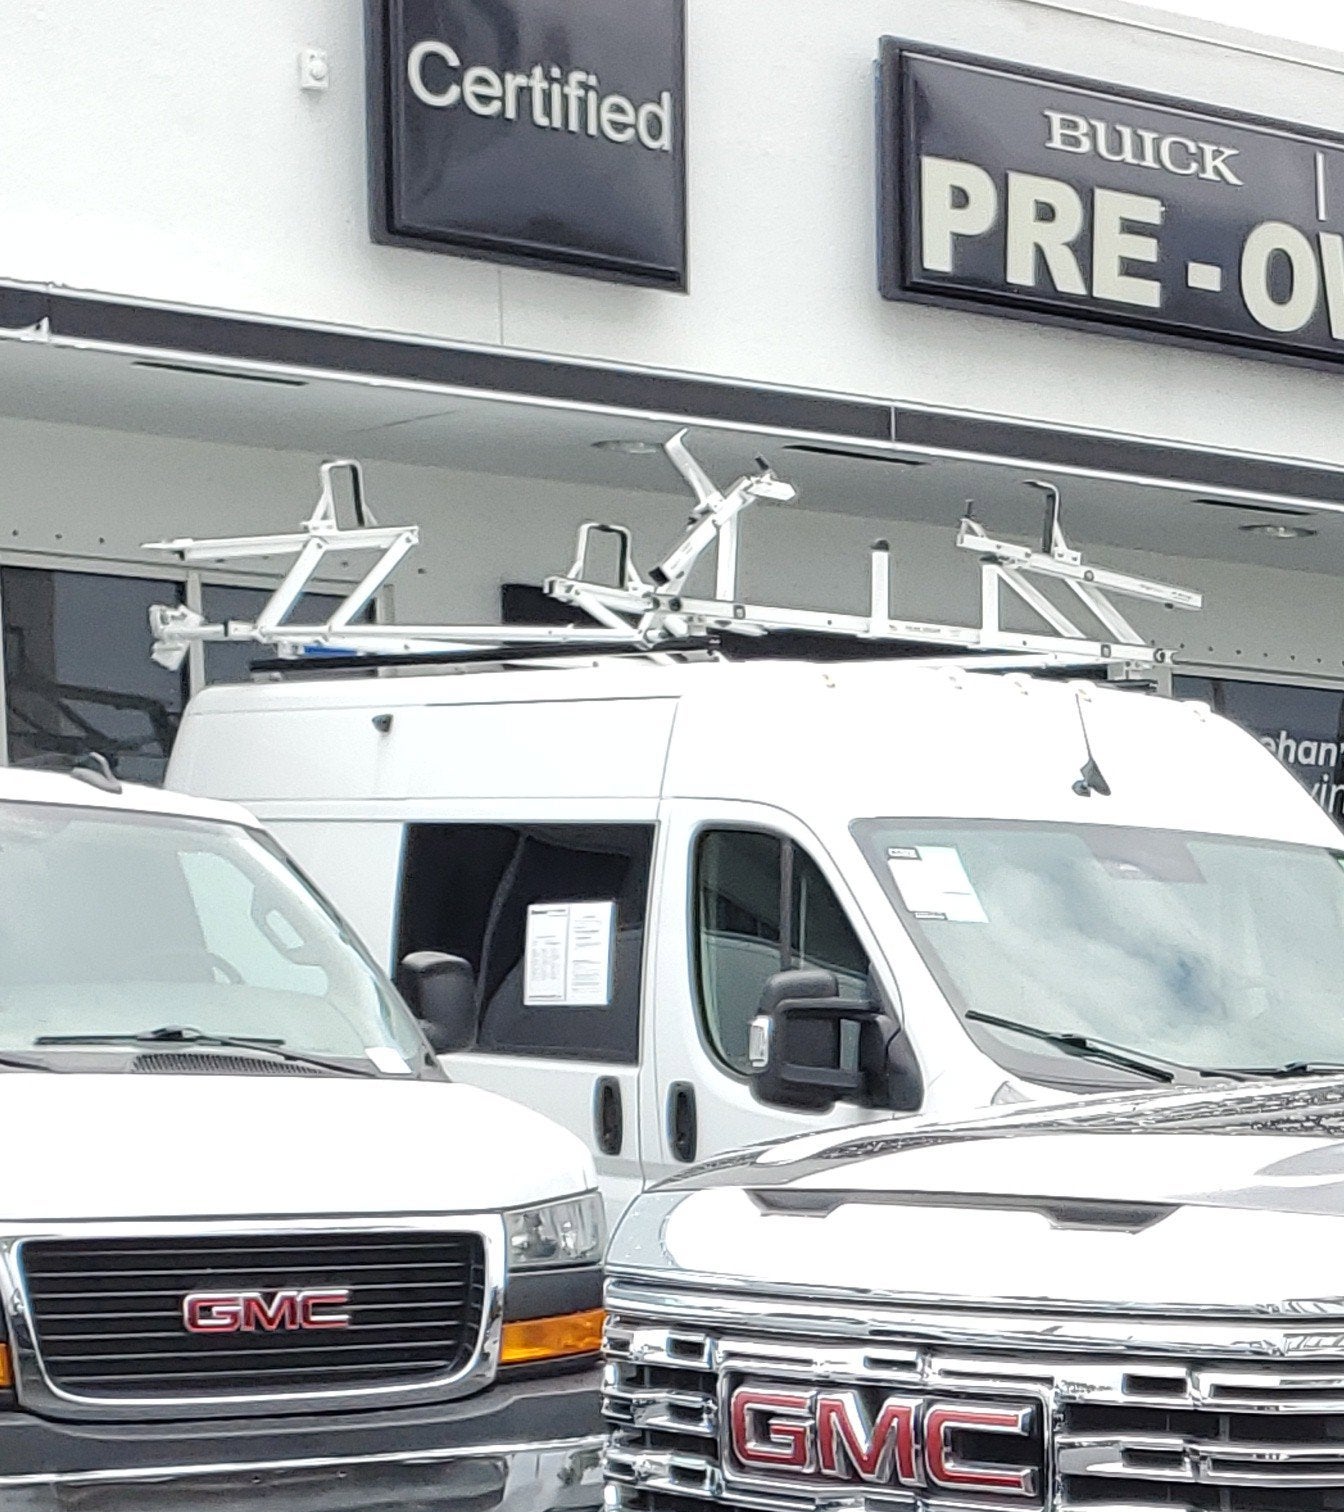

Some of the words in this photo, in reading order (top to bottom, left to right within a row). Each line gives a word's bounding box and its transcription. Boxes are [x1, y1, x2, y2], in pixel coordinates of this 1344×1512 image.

[408, 41, 674, 153] Certified
[1044, 109, 1244, 187] BUICK
[182, 1286, 351, 1333] GMC
[730, 1382, 1037, 1498] GMC
